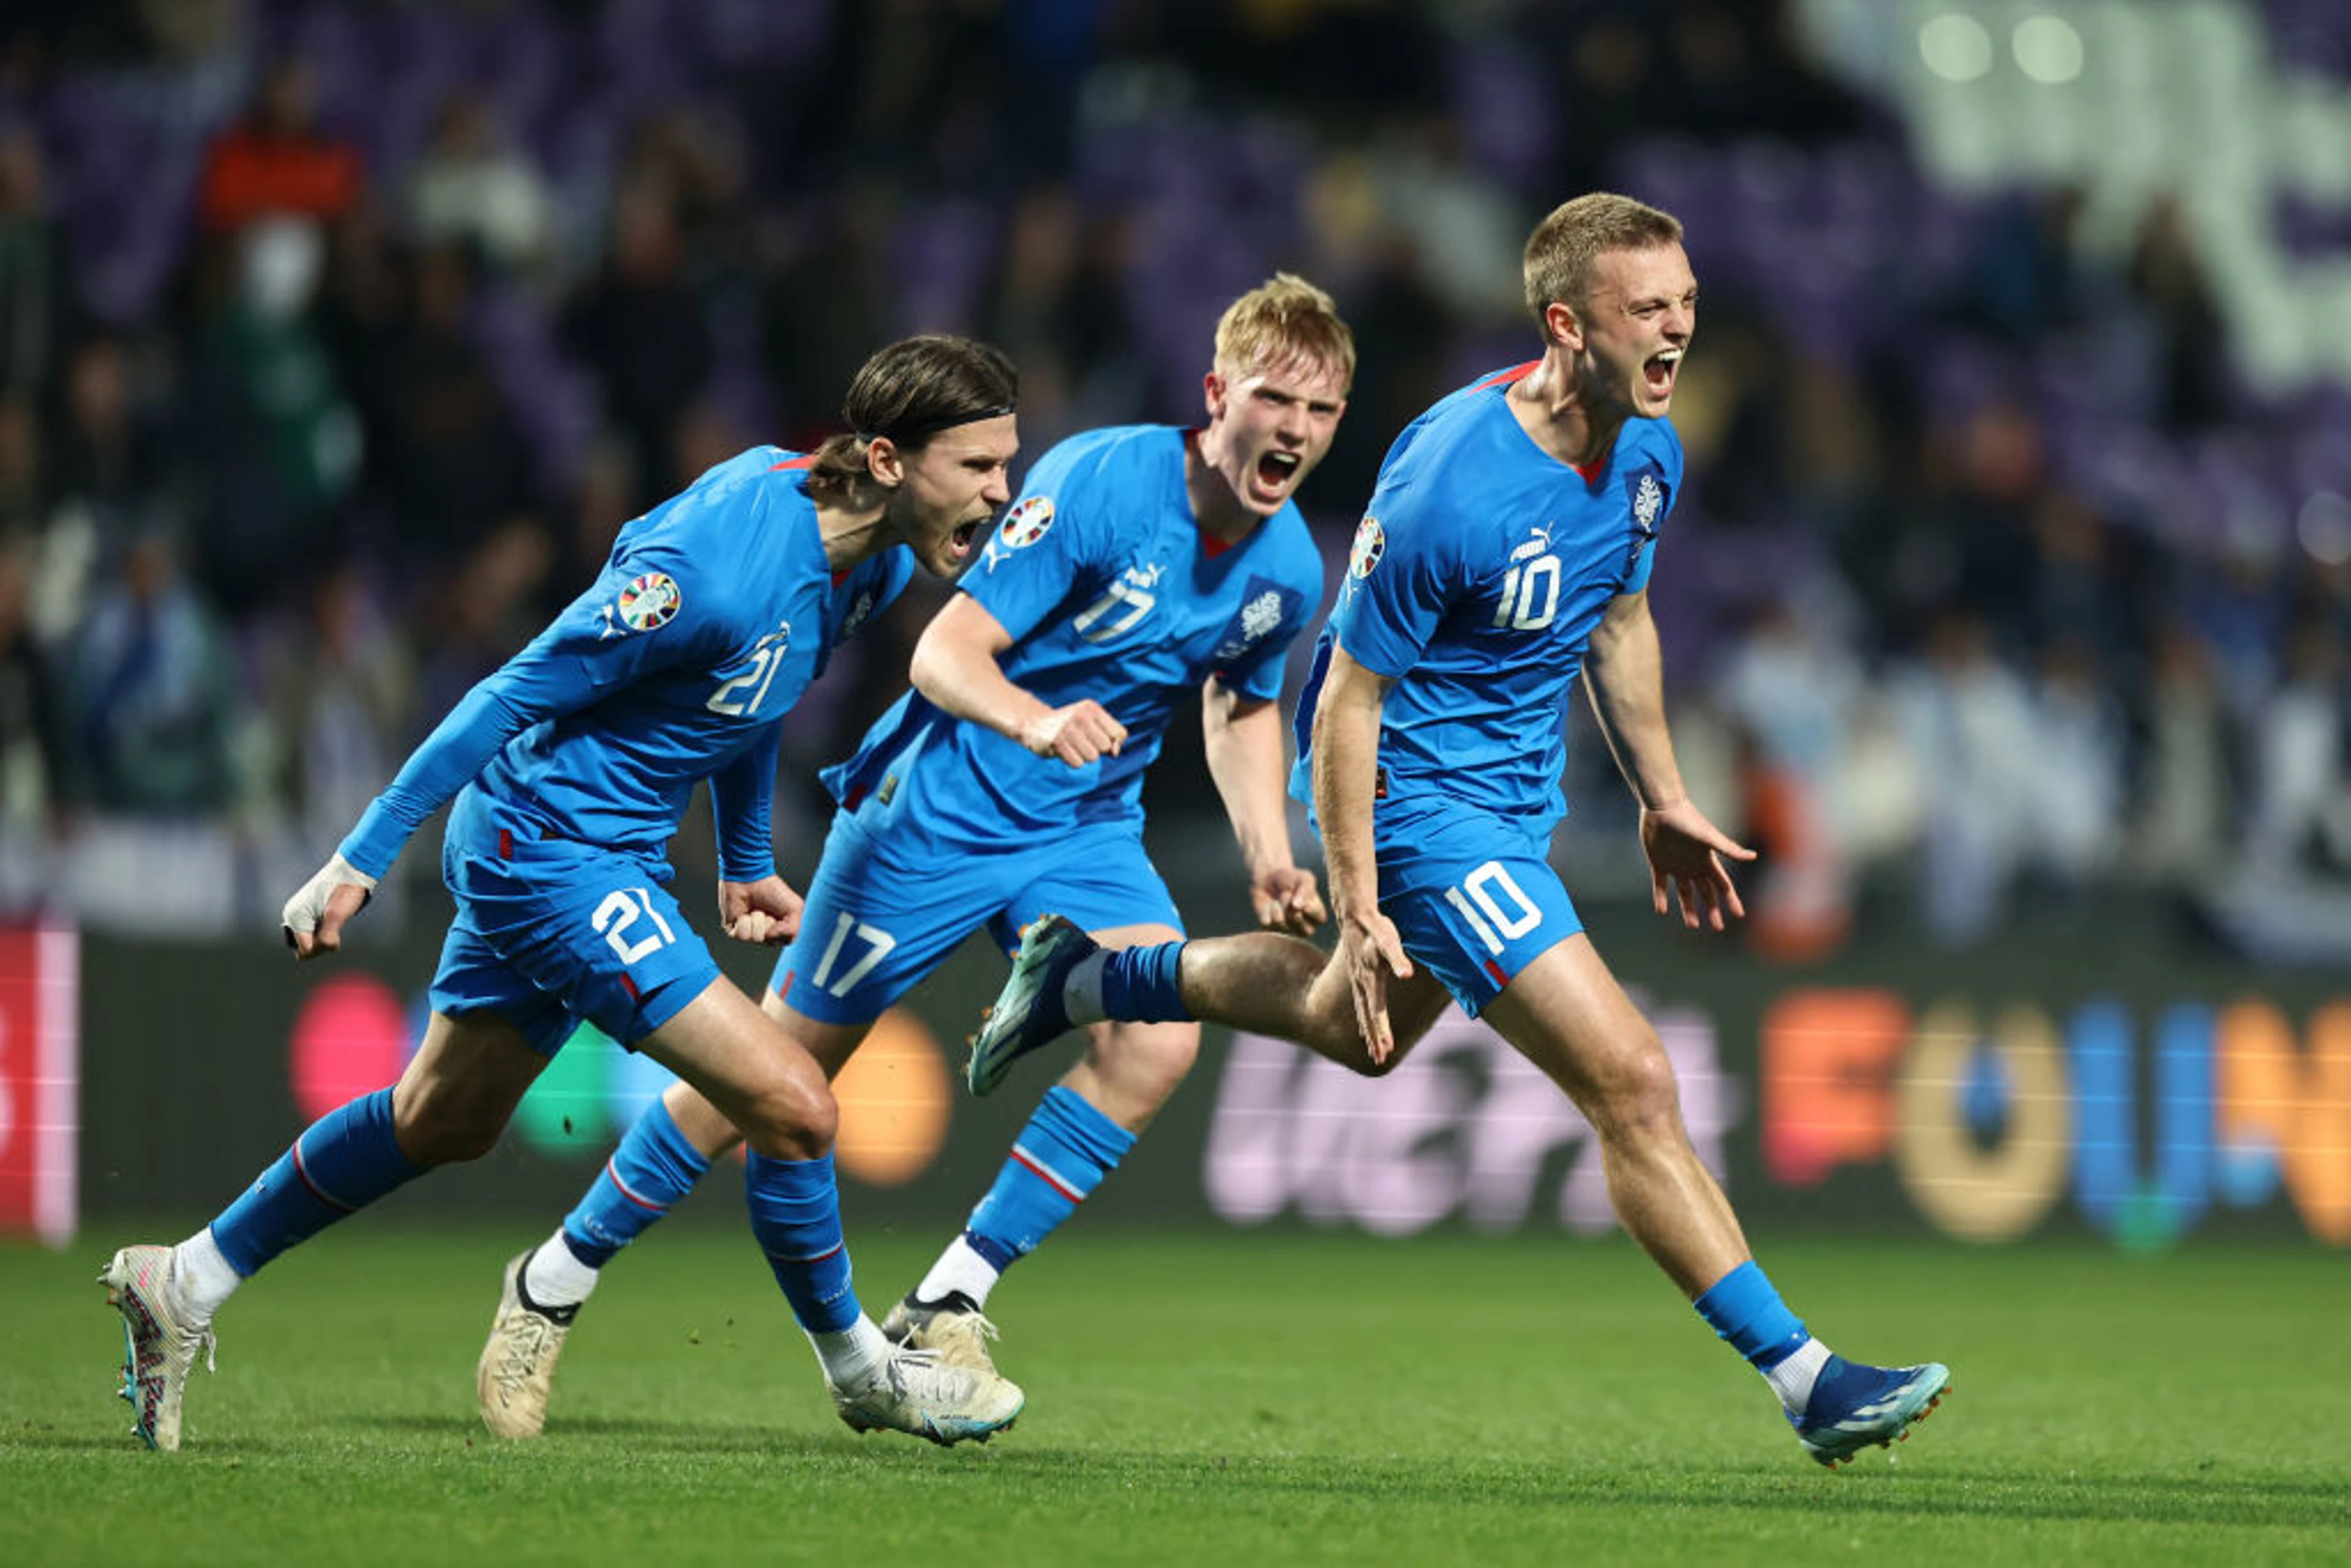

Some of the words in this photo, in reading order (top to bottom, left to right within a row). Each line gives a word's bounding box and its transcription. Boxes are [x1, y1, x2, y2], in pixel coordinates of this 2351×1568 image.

[1073, 580, 1155, 643] 17
[1491, 555, 1562, 630] 10
[705, 643, 788, 716] 21
[591, 887, 677, 966] 21
[1444, 860, 1543, 956] 10
[812, 910, 898, 998] 17
